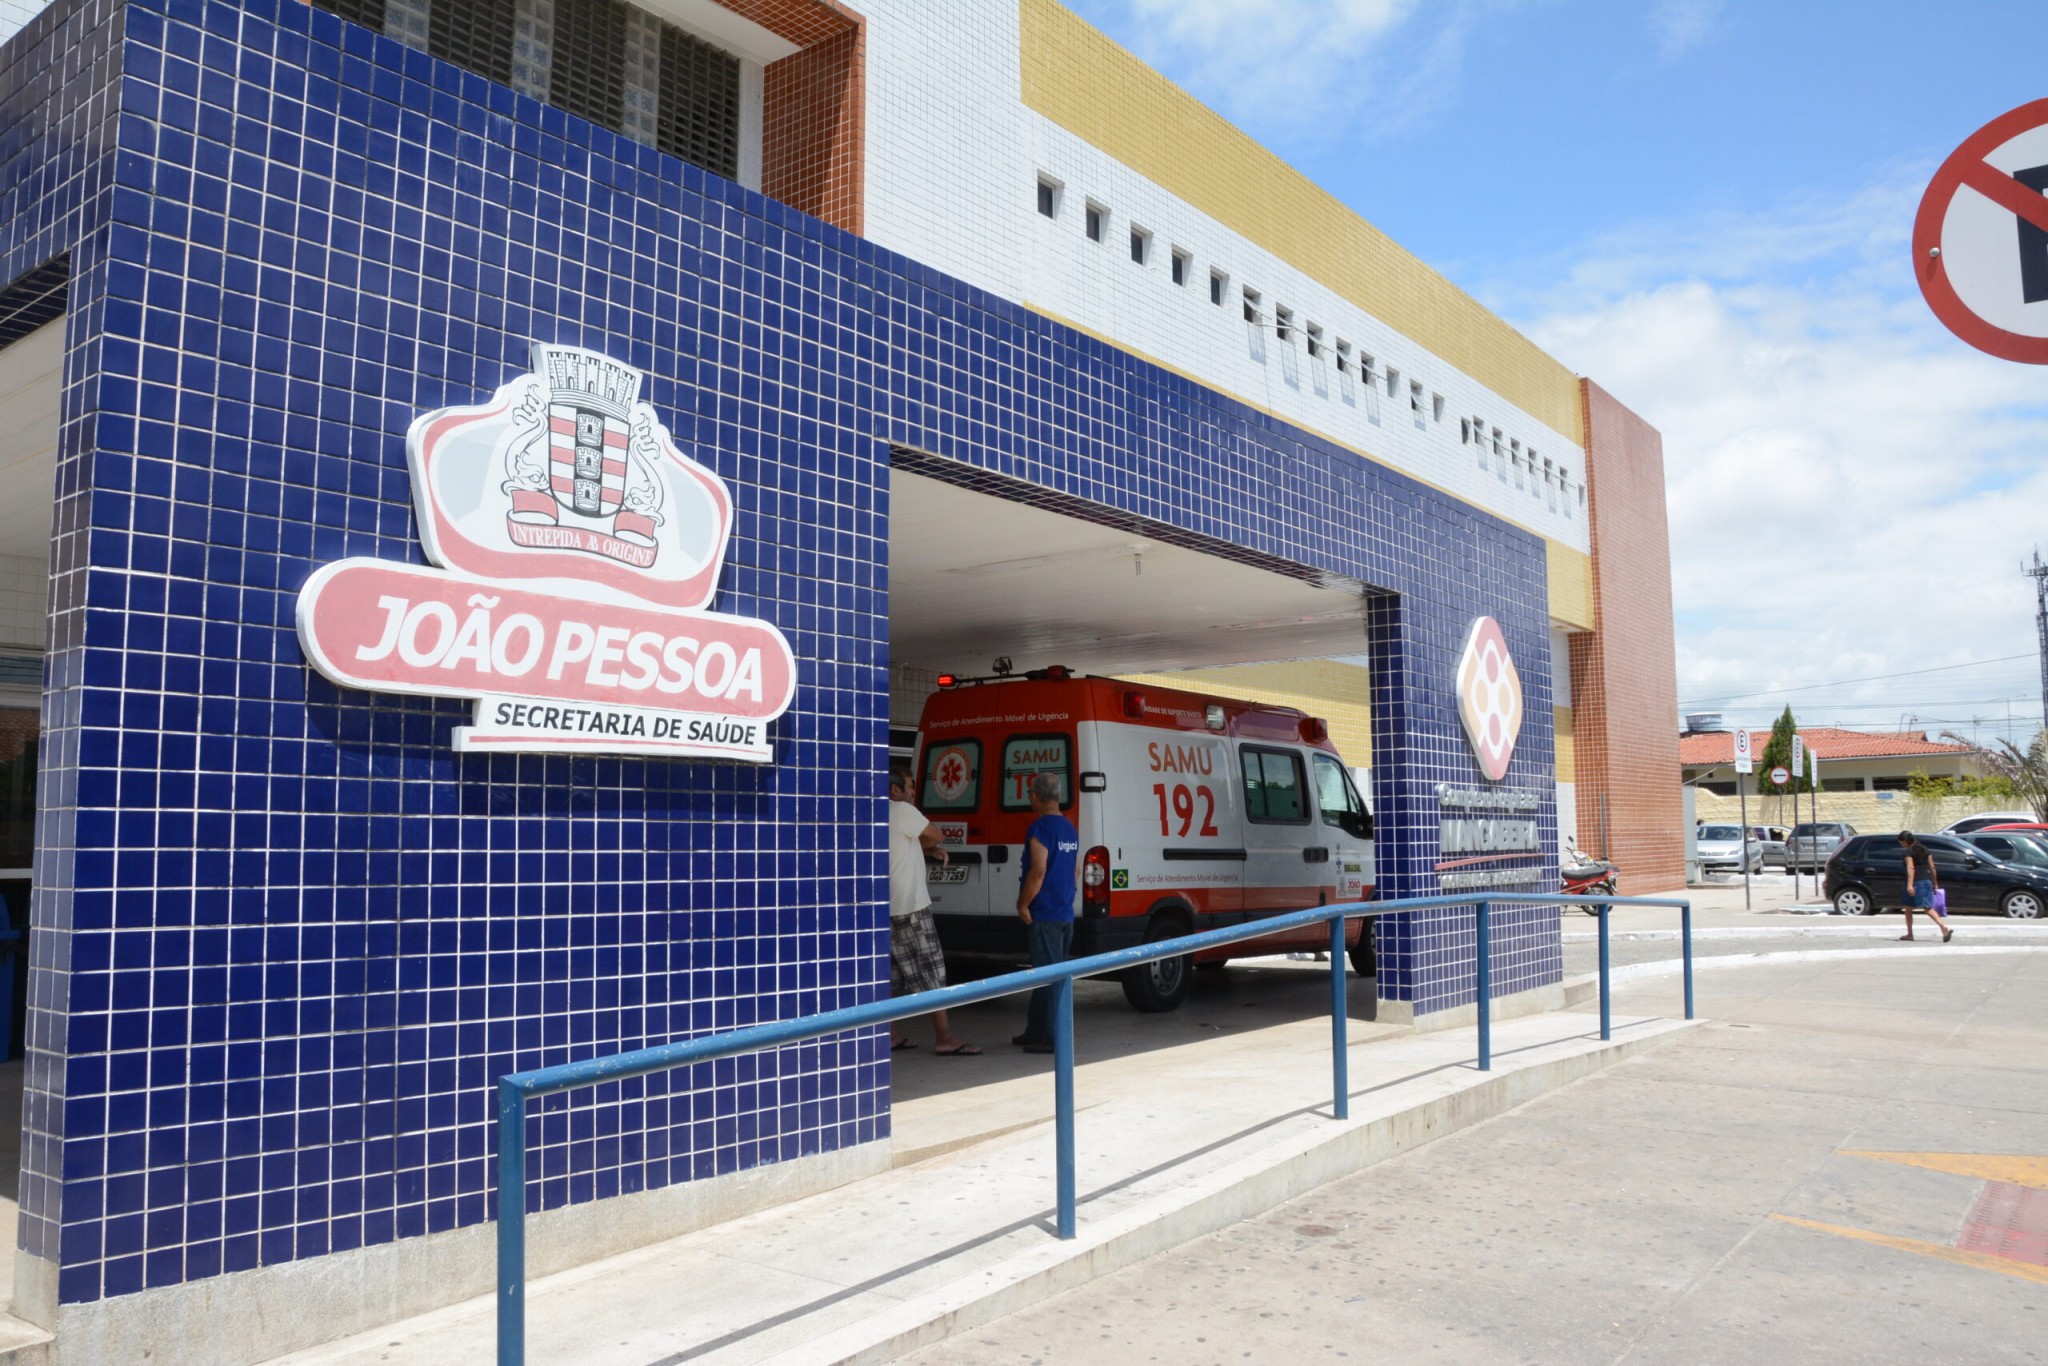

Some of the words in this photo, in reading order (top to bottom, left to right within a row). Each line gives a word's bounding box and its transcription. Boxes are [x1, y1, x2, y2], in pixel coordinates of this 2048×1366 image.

[511, 523, 582, 548] INTREPIDA
[602, 538, 655, 566] ORIGINE
[355, 593, 545, 677] JOÃO
[546, 620, 763, 703] PESSOA
[494, 702, 646, 737] SECRETARIA
[653, 717, 682, 739] DE
[687, 716, 757, 746] SAÚDE
[929, 719, 950, 728] Serviço
[952, 718, 960, 726] de
[960, 715, 1003, 725] Atendimento
[1005, 712, 1026, 723] Móvel
[1027, 711, 1037, 721] de
[1013, 748, 1060, 765] SAMU
[1148, 742, 1212, 775] SAMU
[1153, 783, 1218, 838] 192
[1157, 874, 1164, 882] de
